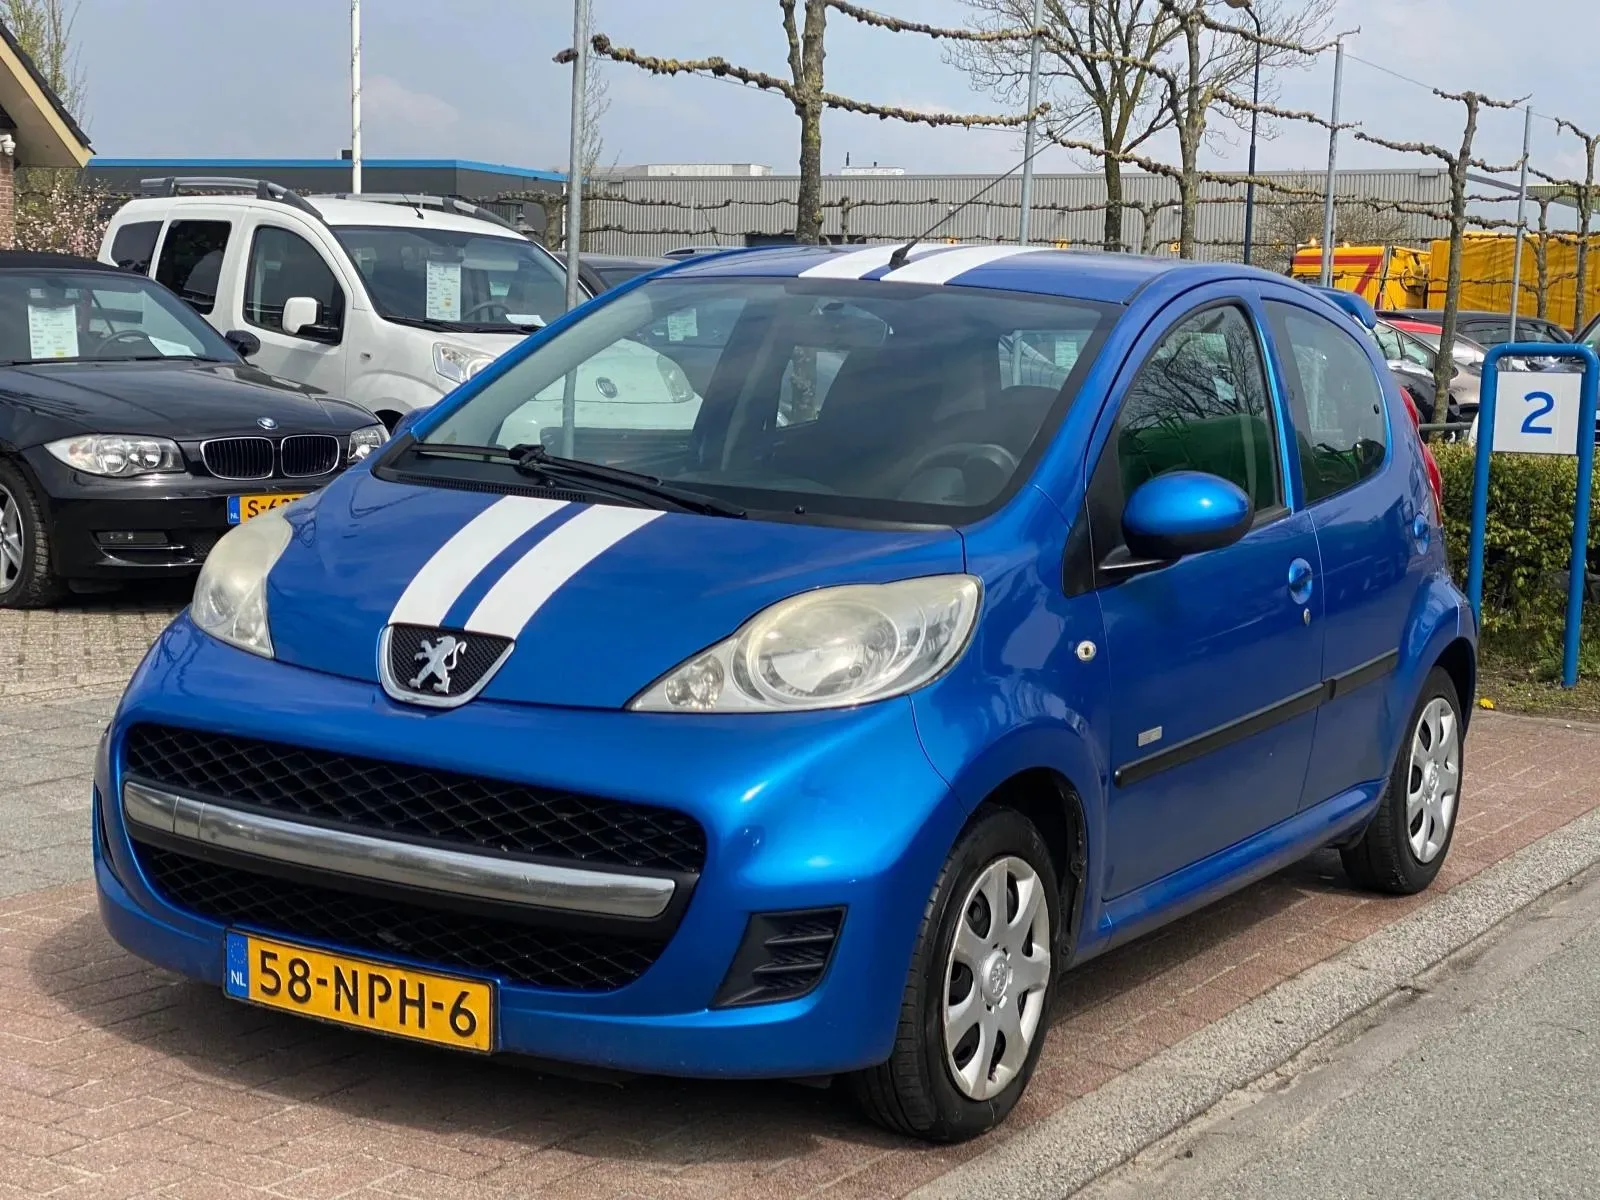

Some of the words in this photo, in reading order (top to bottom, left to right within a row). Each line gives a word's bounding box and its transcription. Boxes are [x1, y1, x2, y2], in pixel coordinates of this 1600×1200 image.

[1520, 391, 1555, 434] 2
[230, 512, 240, 520] NL
[230, 969, 247, 988] NL
[259, 949, 478, 1038] 58-NPH-6
